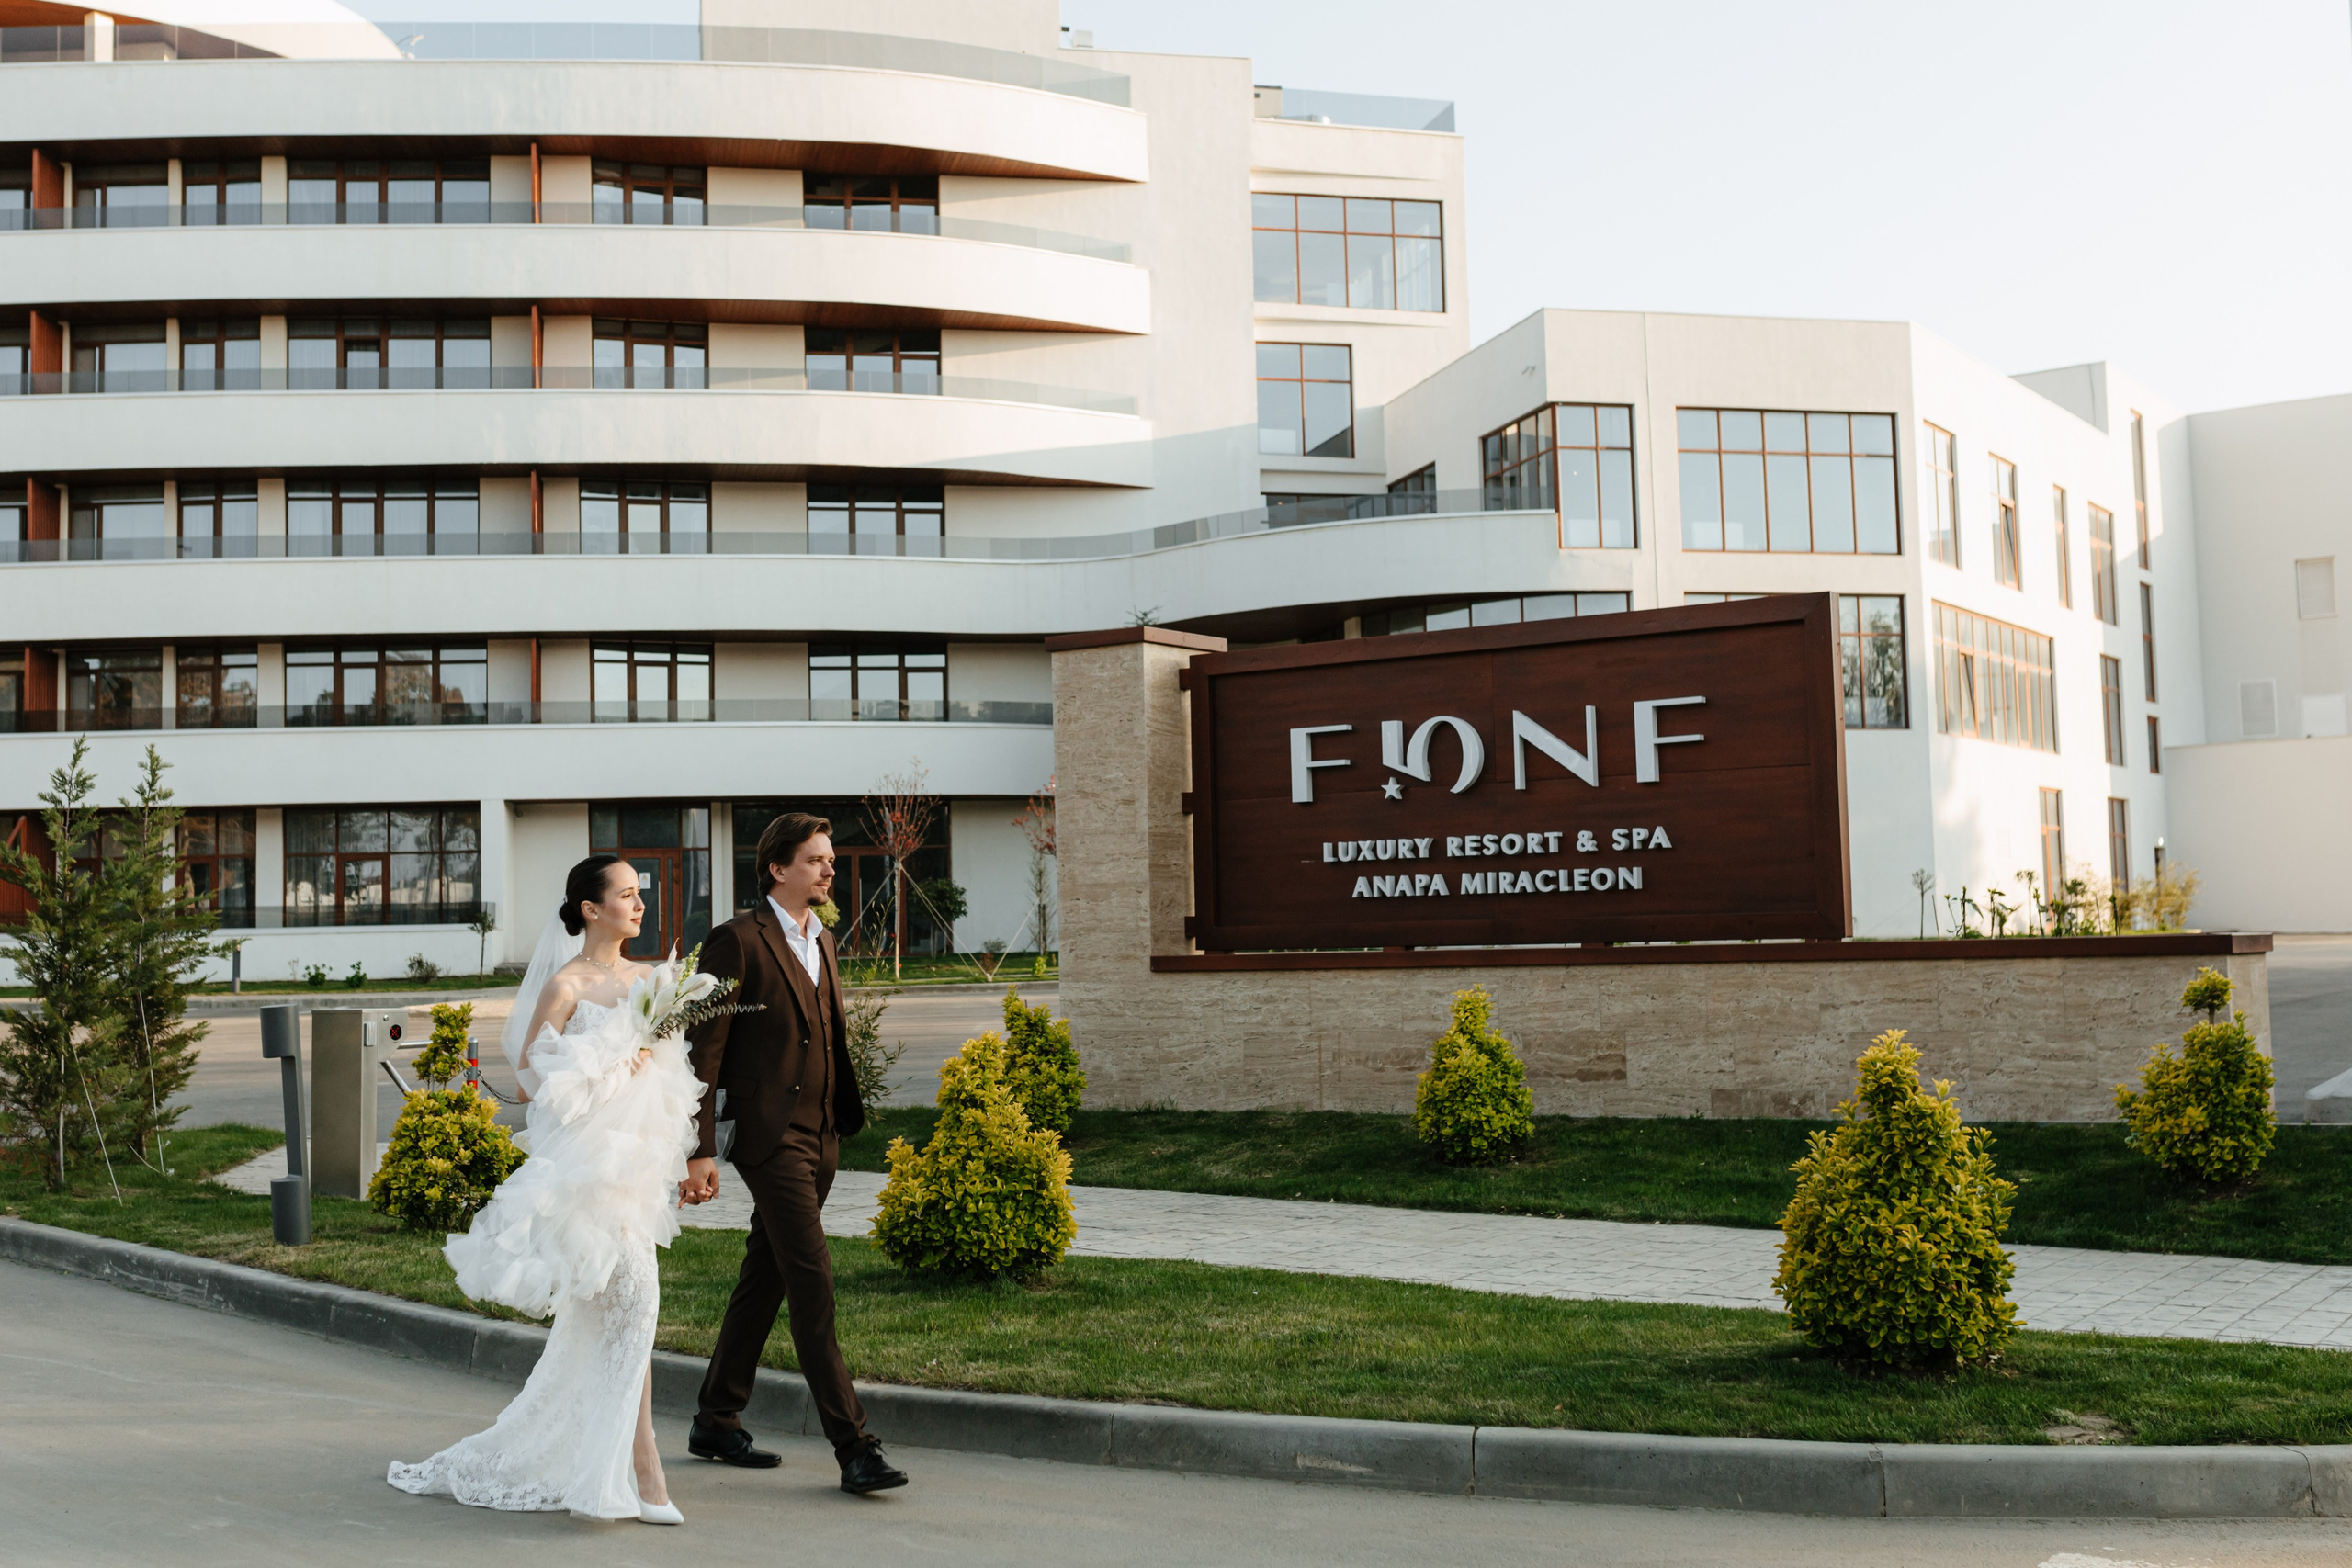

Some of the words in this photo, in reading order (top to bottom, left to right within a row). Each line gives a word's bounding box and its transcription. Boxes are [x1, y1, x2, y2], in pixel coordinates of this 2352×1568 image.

[1322, 837, 1434, 863] LUXURY
[1446, 831, 1563, 858] RESORT
[1576, 829, 1599, 852] &
[1611, 825, 1673, 852] SPA
[1351, 874, 1450, 898] ANAPA
[1460, 866, 1643, 896] MIRACLEON
